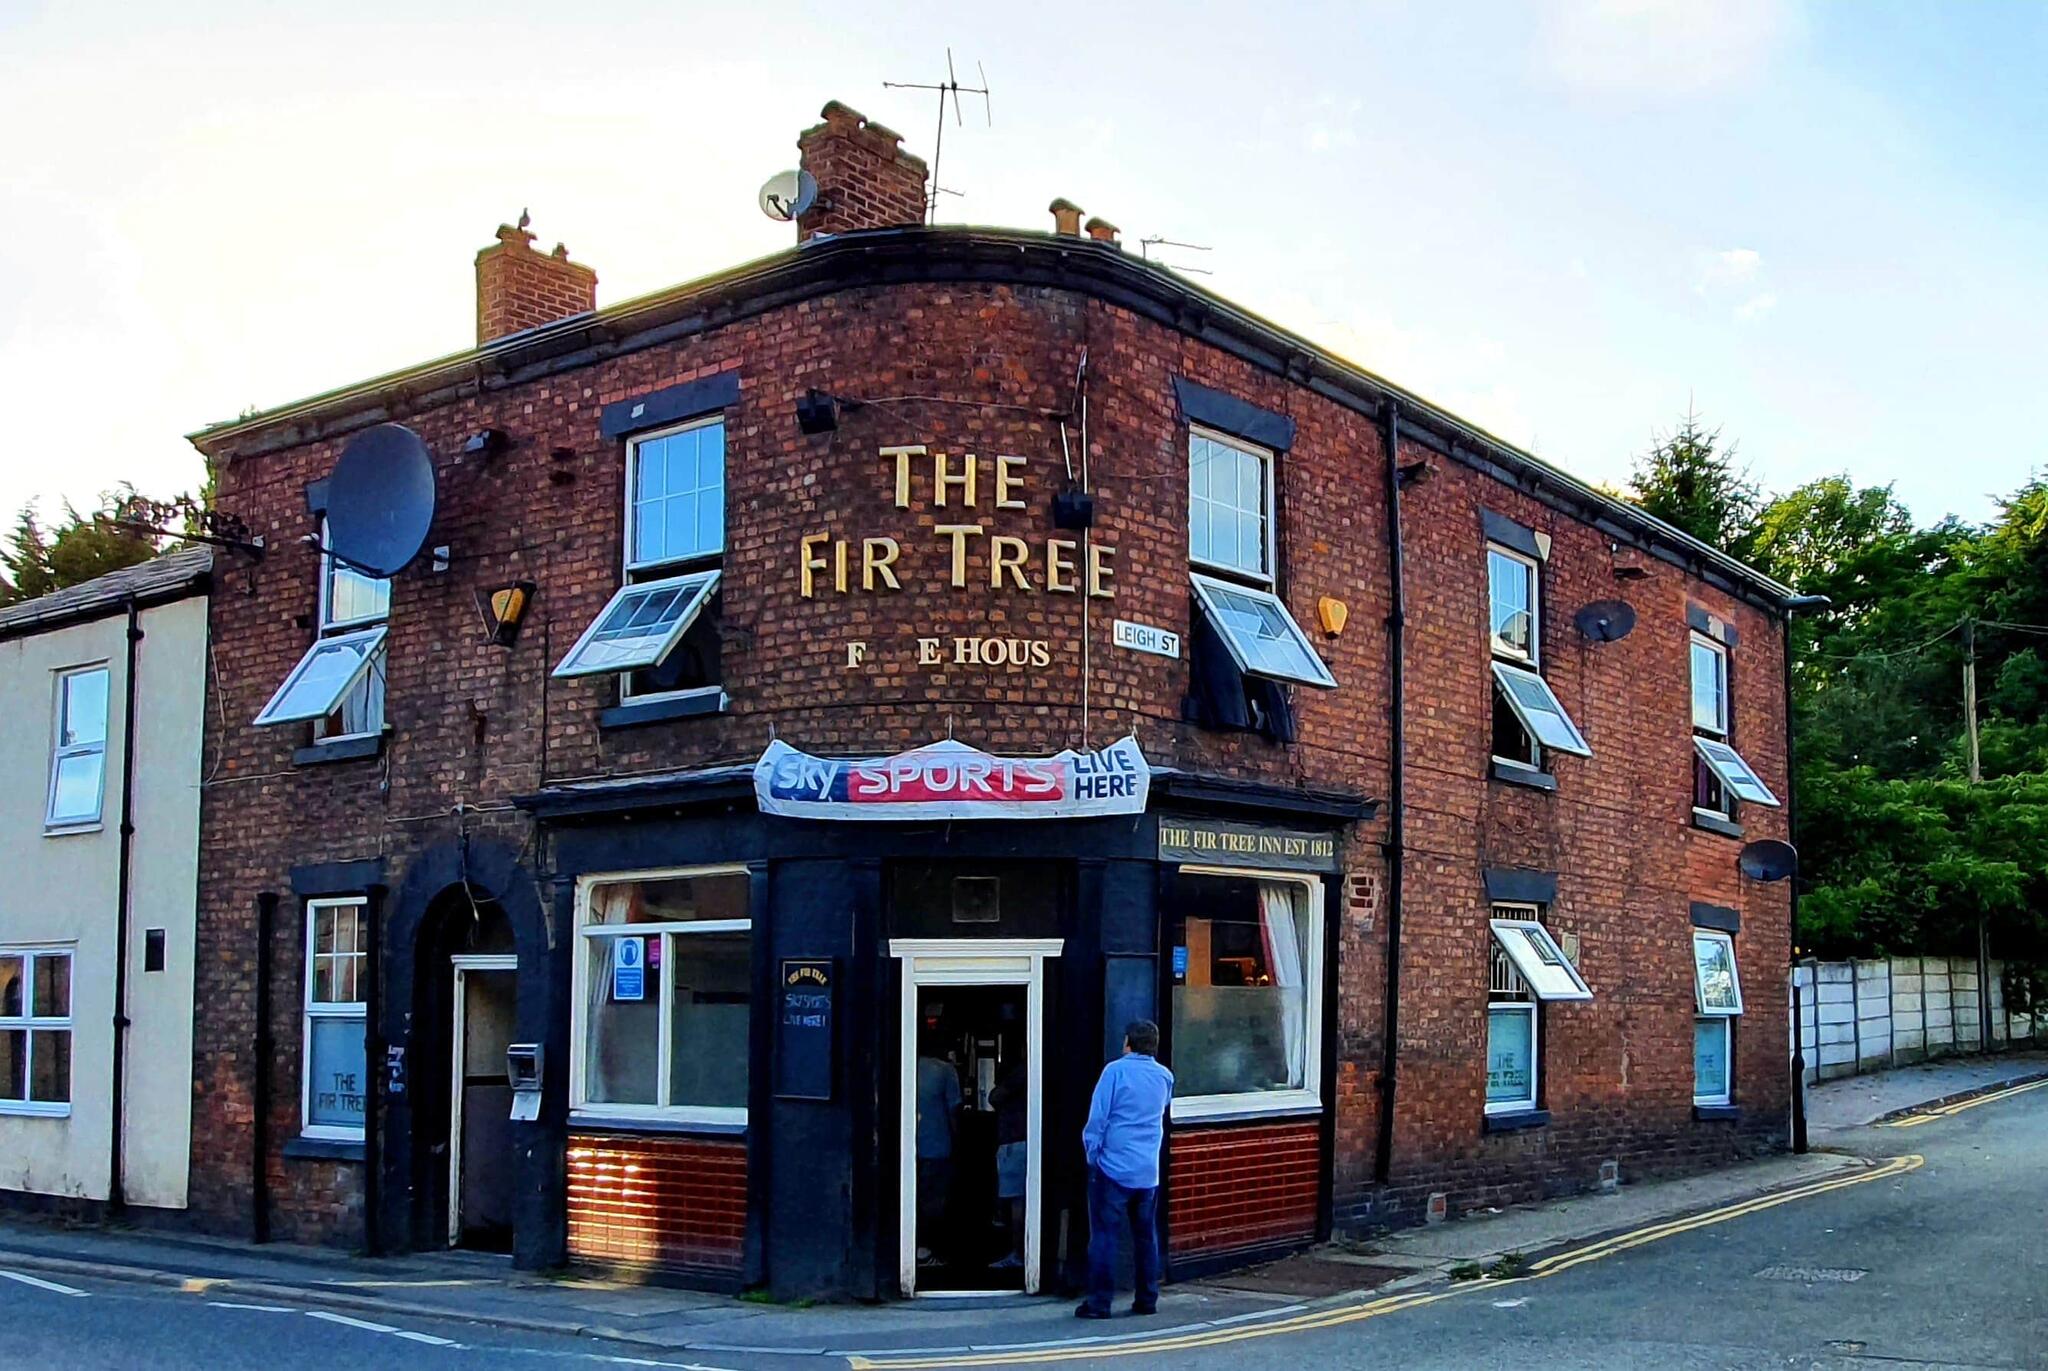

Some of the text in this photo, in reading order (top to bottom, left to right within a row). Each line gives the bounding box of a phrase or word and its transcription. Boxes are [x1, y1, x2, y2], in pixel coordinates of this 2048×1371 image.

[879, 445, 1027, 509] THE
[801, 525, 1116, 598] FIR TREE
[1117, 624, 1176, 653] LEIGH ST
[858, 758, 1057, 794] SPORTS
[1072, 750, 1134, 773] LIVE
[1075, 774, 1137, 800] HERE
[1161, 828, 1334, 857] THE FIR TREE INN EST 1812
[333, 1073, 356, 1091] THE
